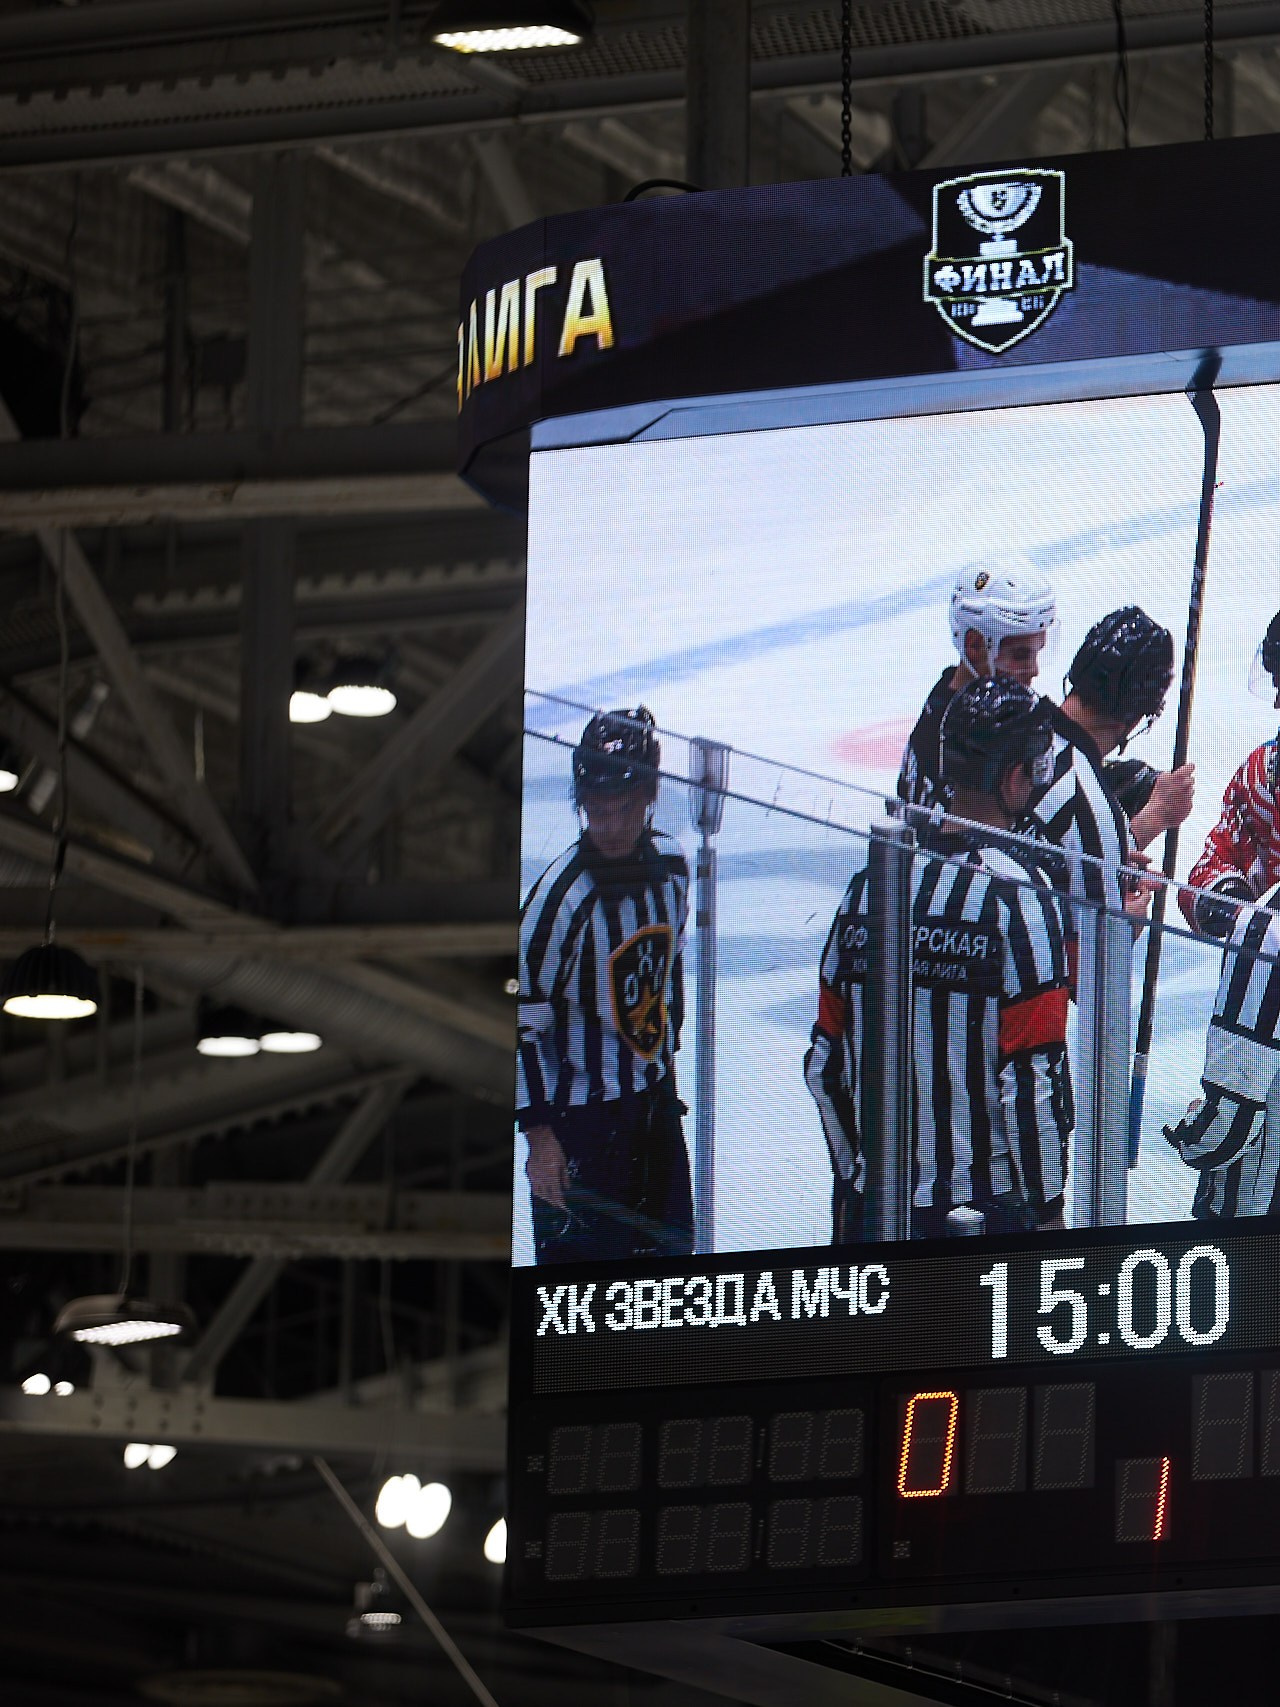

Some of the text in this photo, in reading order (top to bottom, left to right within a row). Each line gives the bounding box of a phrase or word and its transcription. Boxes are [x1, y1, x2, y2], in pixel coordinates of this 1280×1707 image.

[932, 252, 1066, 293] ФИНАЛ
[536, 1264, 891, 1337] ХК ЗВЕЗДА МЧС
[979, 1245, 1231, 1361] 15:00
[897, 1391, 959, 1498] 0
[1152, 1456, 1171, 1542] 1
